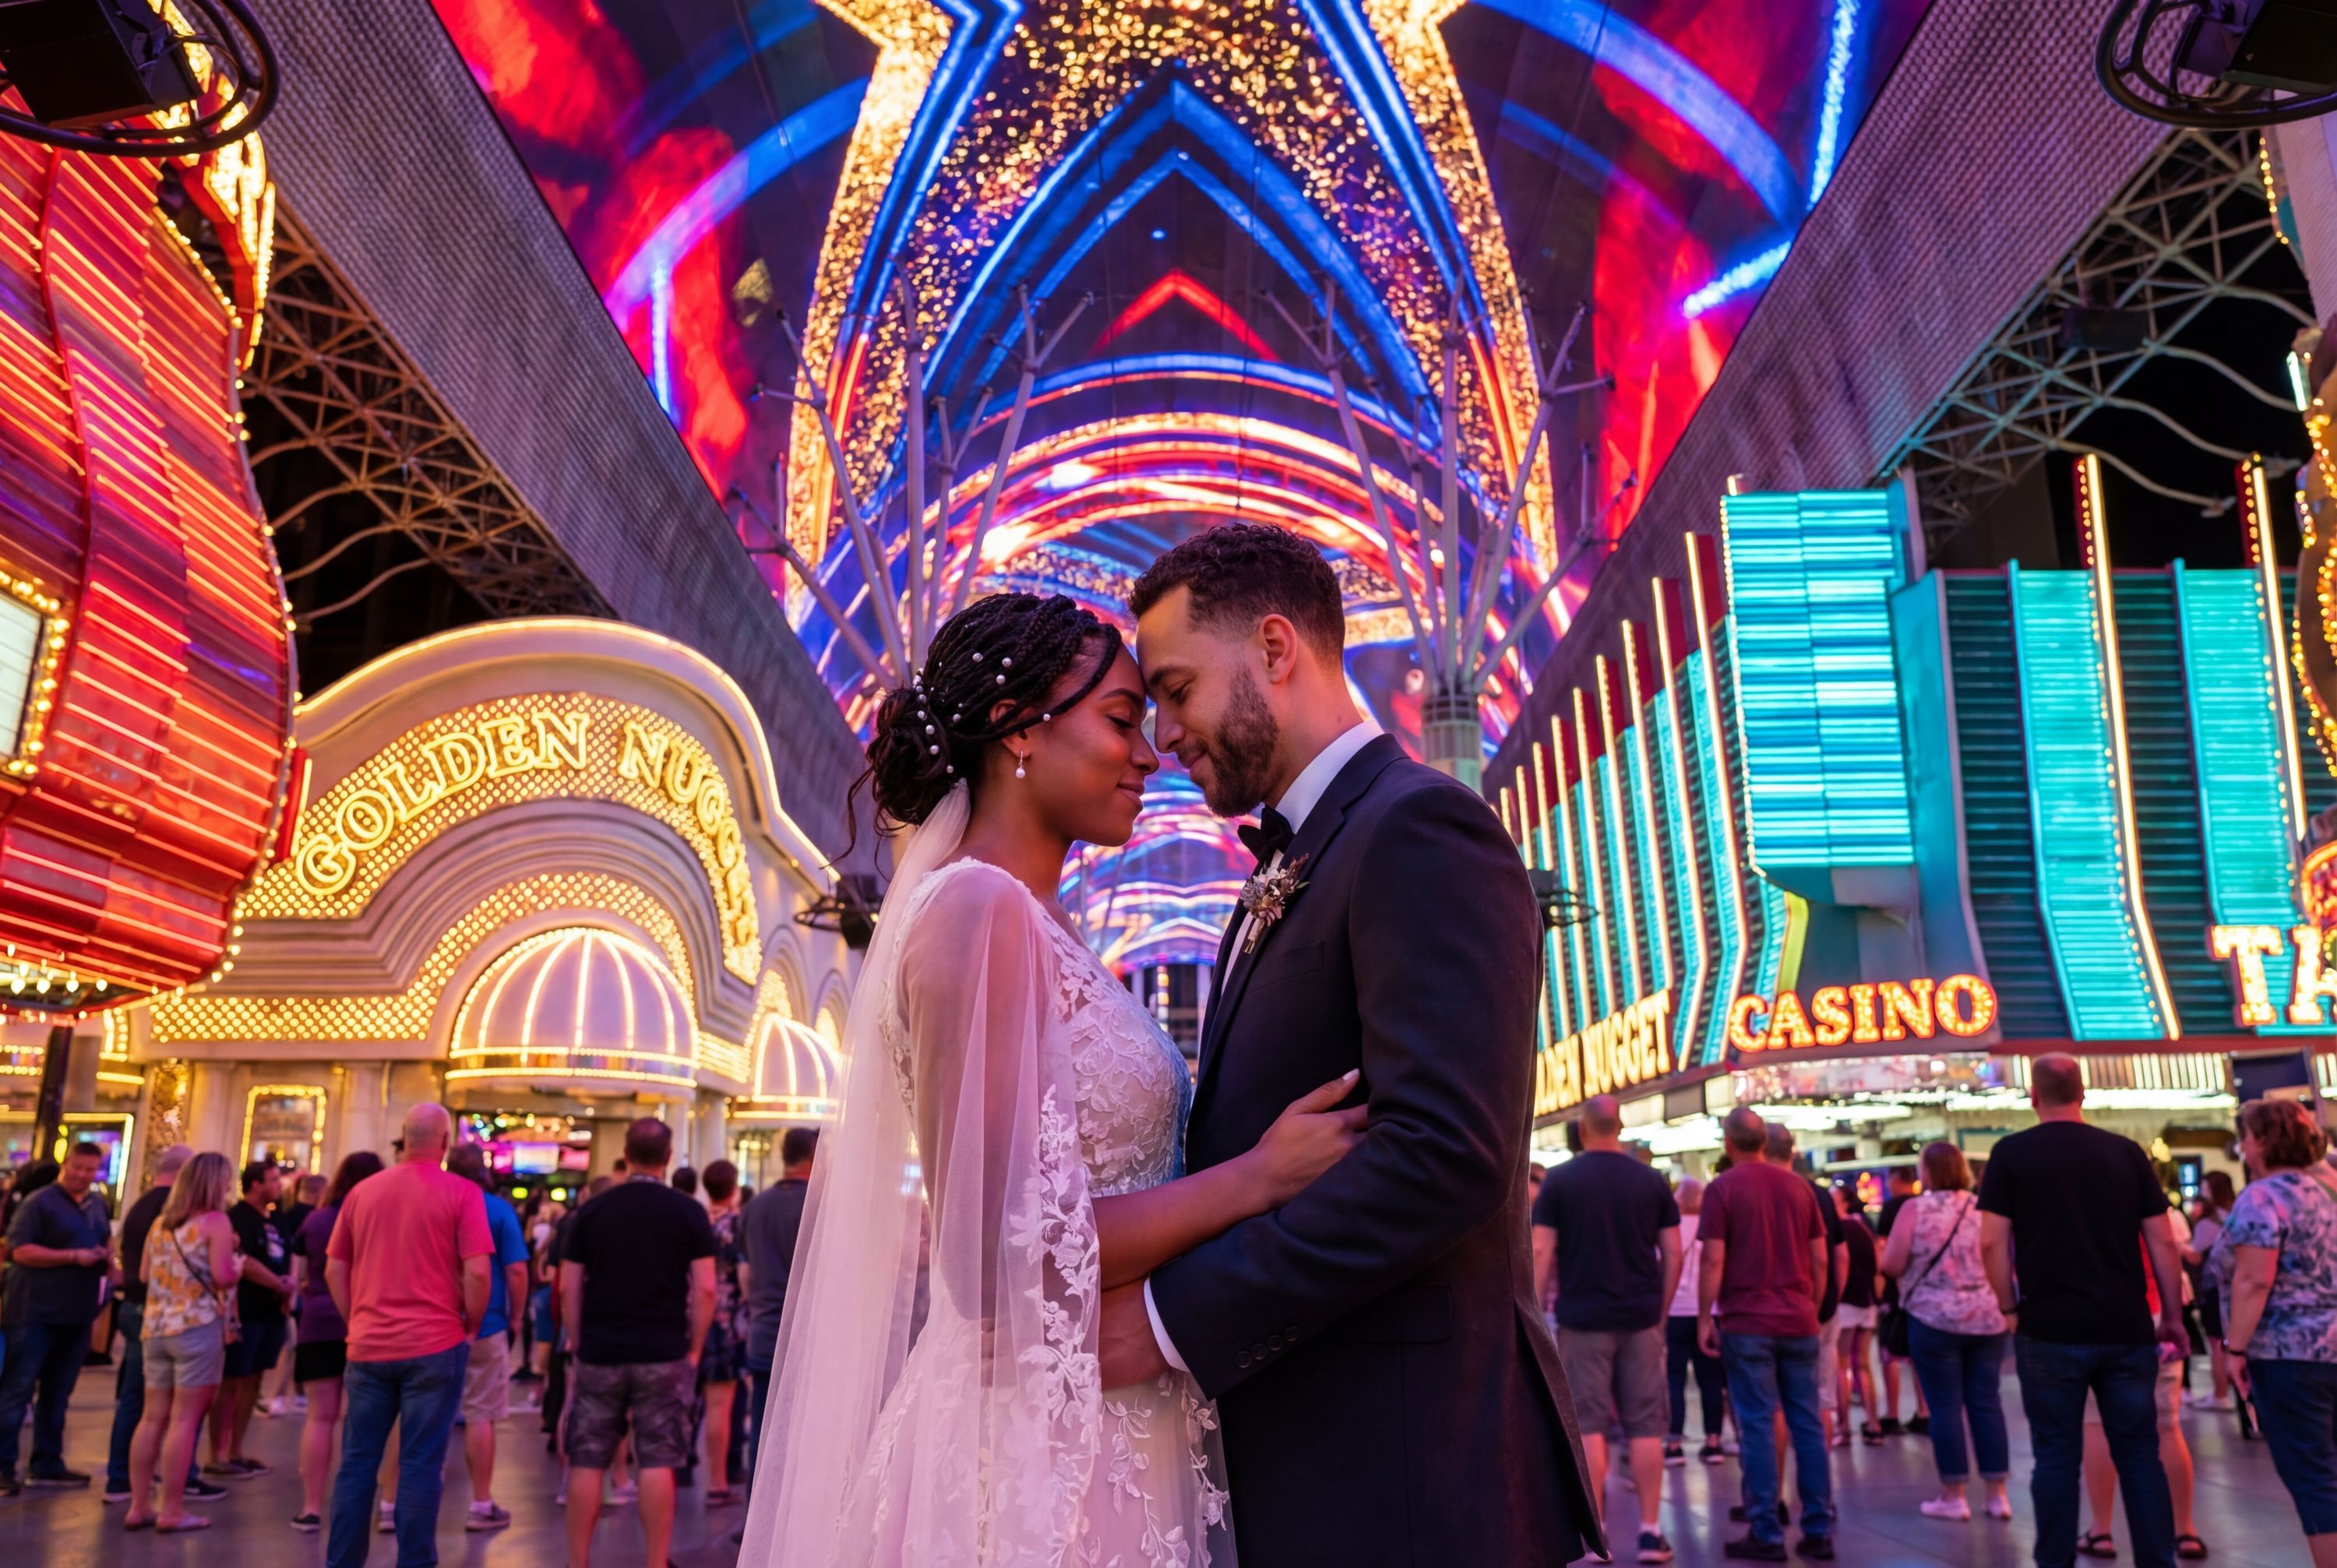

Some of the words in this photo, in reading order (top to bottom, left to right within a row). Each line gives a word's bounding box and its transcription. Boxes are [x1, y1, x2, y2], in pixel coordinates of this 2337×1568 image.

[296, 710, 590, 896] GOLDEN
[1581, 988, 1670, 1098] NUGGET
[1729, 974, 1997, 1052] CASINO
